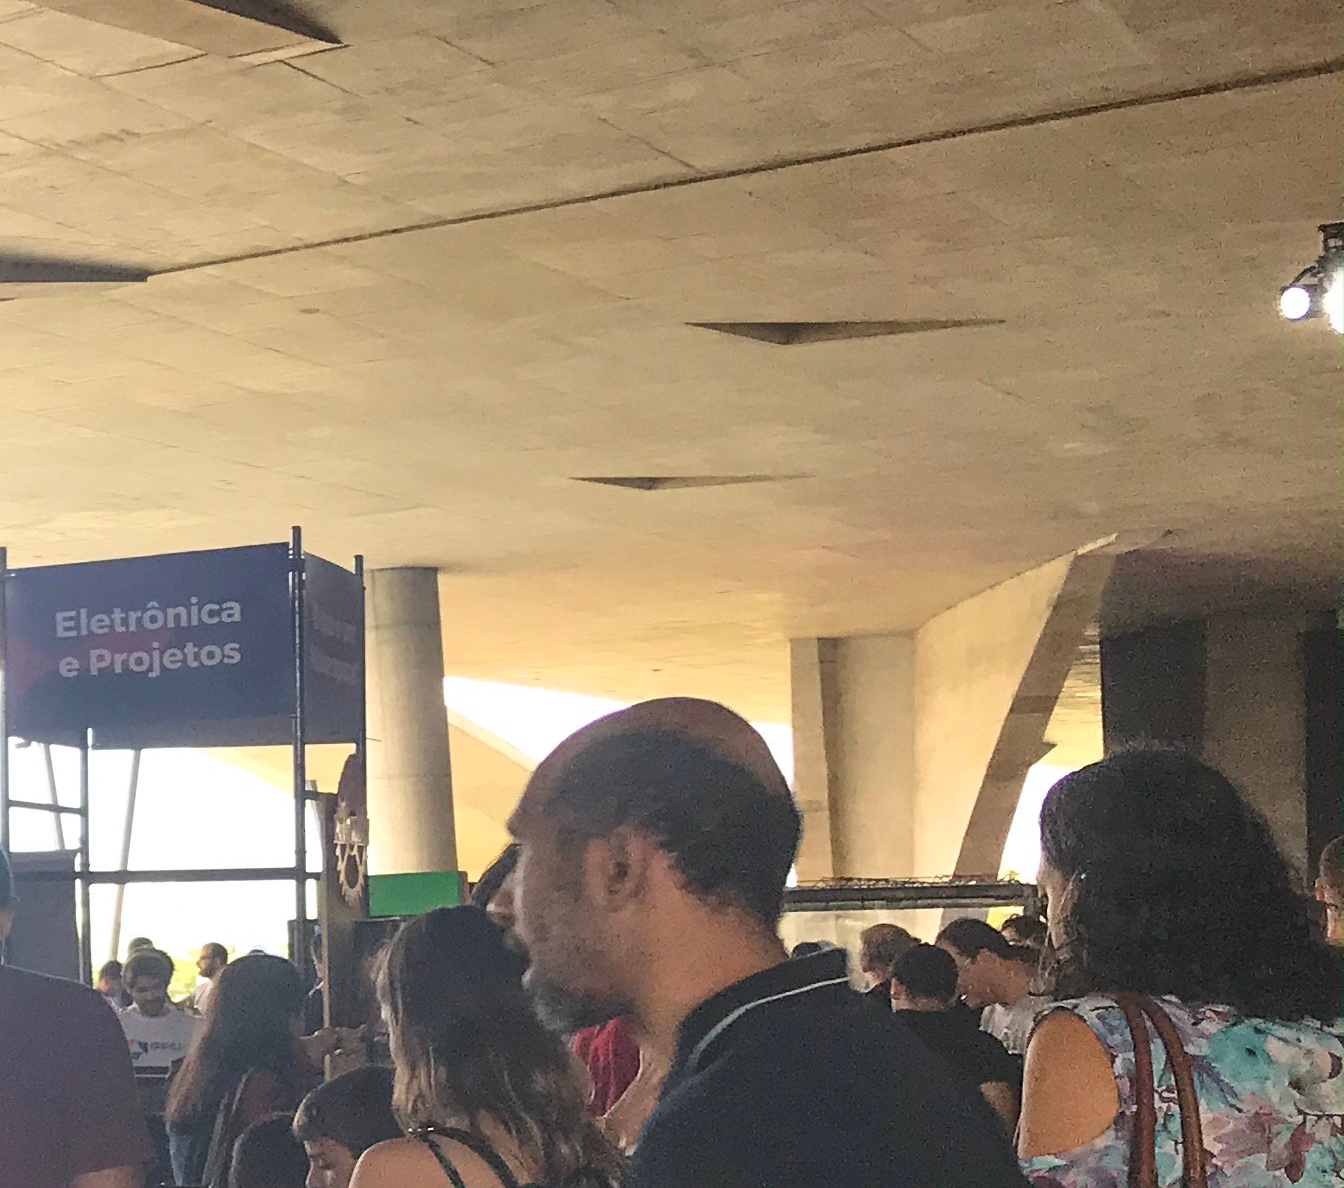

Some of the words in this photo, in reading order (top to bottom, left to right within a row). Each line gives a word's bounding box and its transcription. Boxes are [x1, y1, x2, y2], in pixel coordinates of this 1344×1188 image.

[55, 596, 242, 639] Eletrônica
[59, 655, 80, 678] e
[90, 640, 242, 678] Projetos
